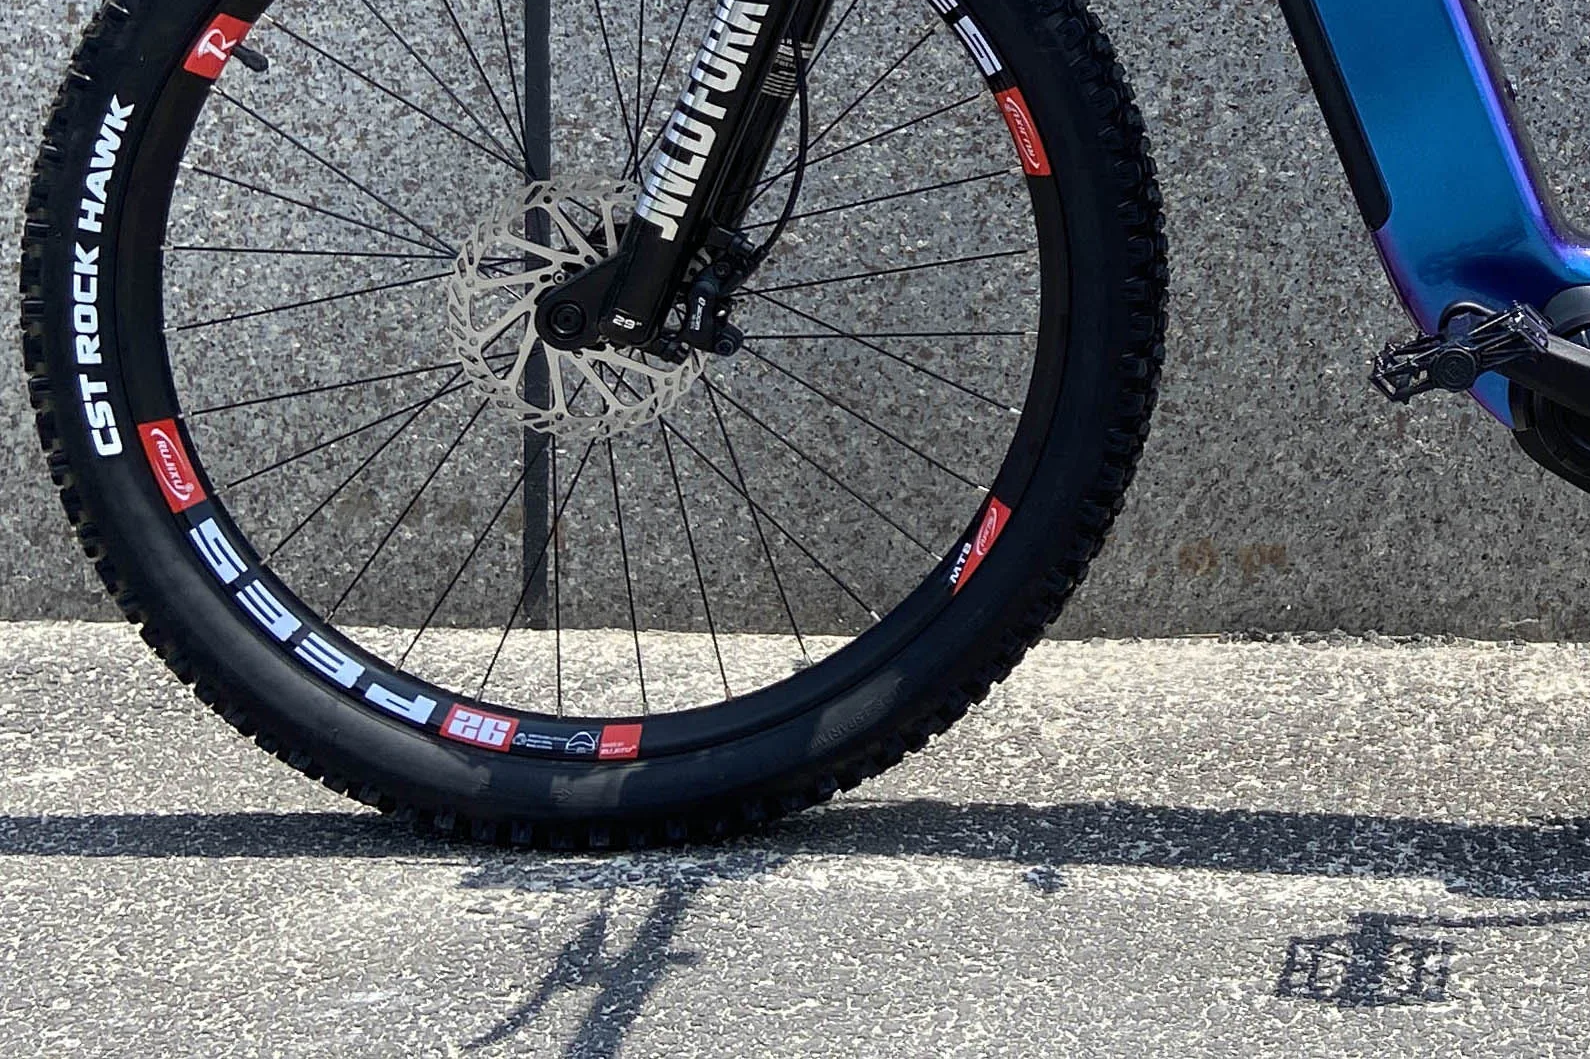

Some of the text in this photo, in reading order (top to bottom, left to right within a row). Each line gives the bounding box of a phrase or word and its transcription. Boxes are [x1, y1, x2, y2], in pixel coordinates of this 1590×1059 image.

[73, 93, 135, 457] CST ROCK HAWK
[949, 542, 972, 584] MTB
